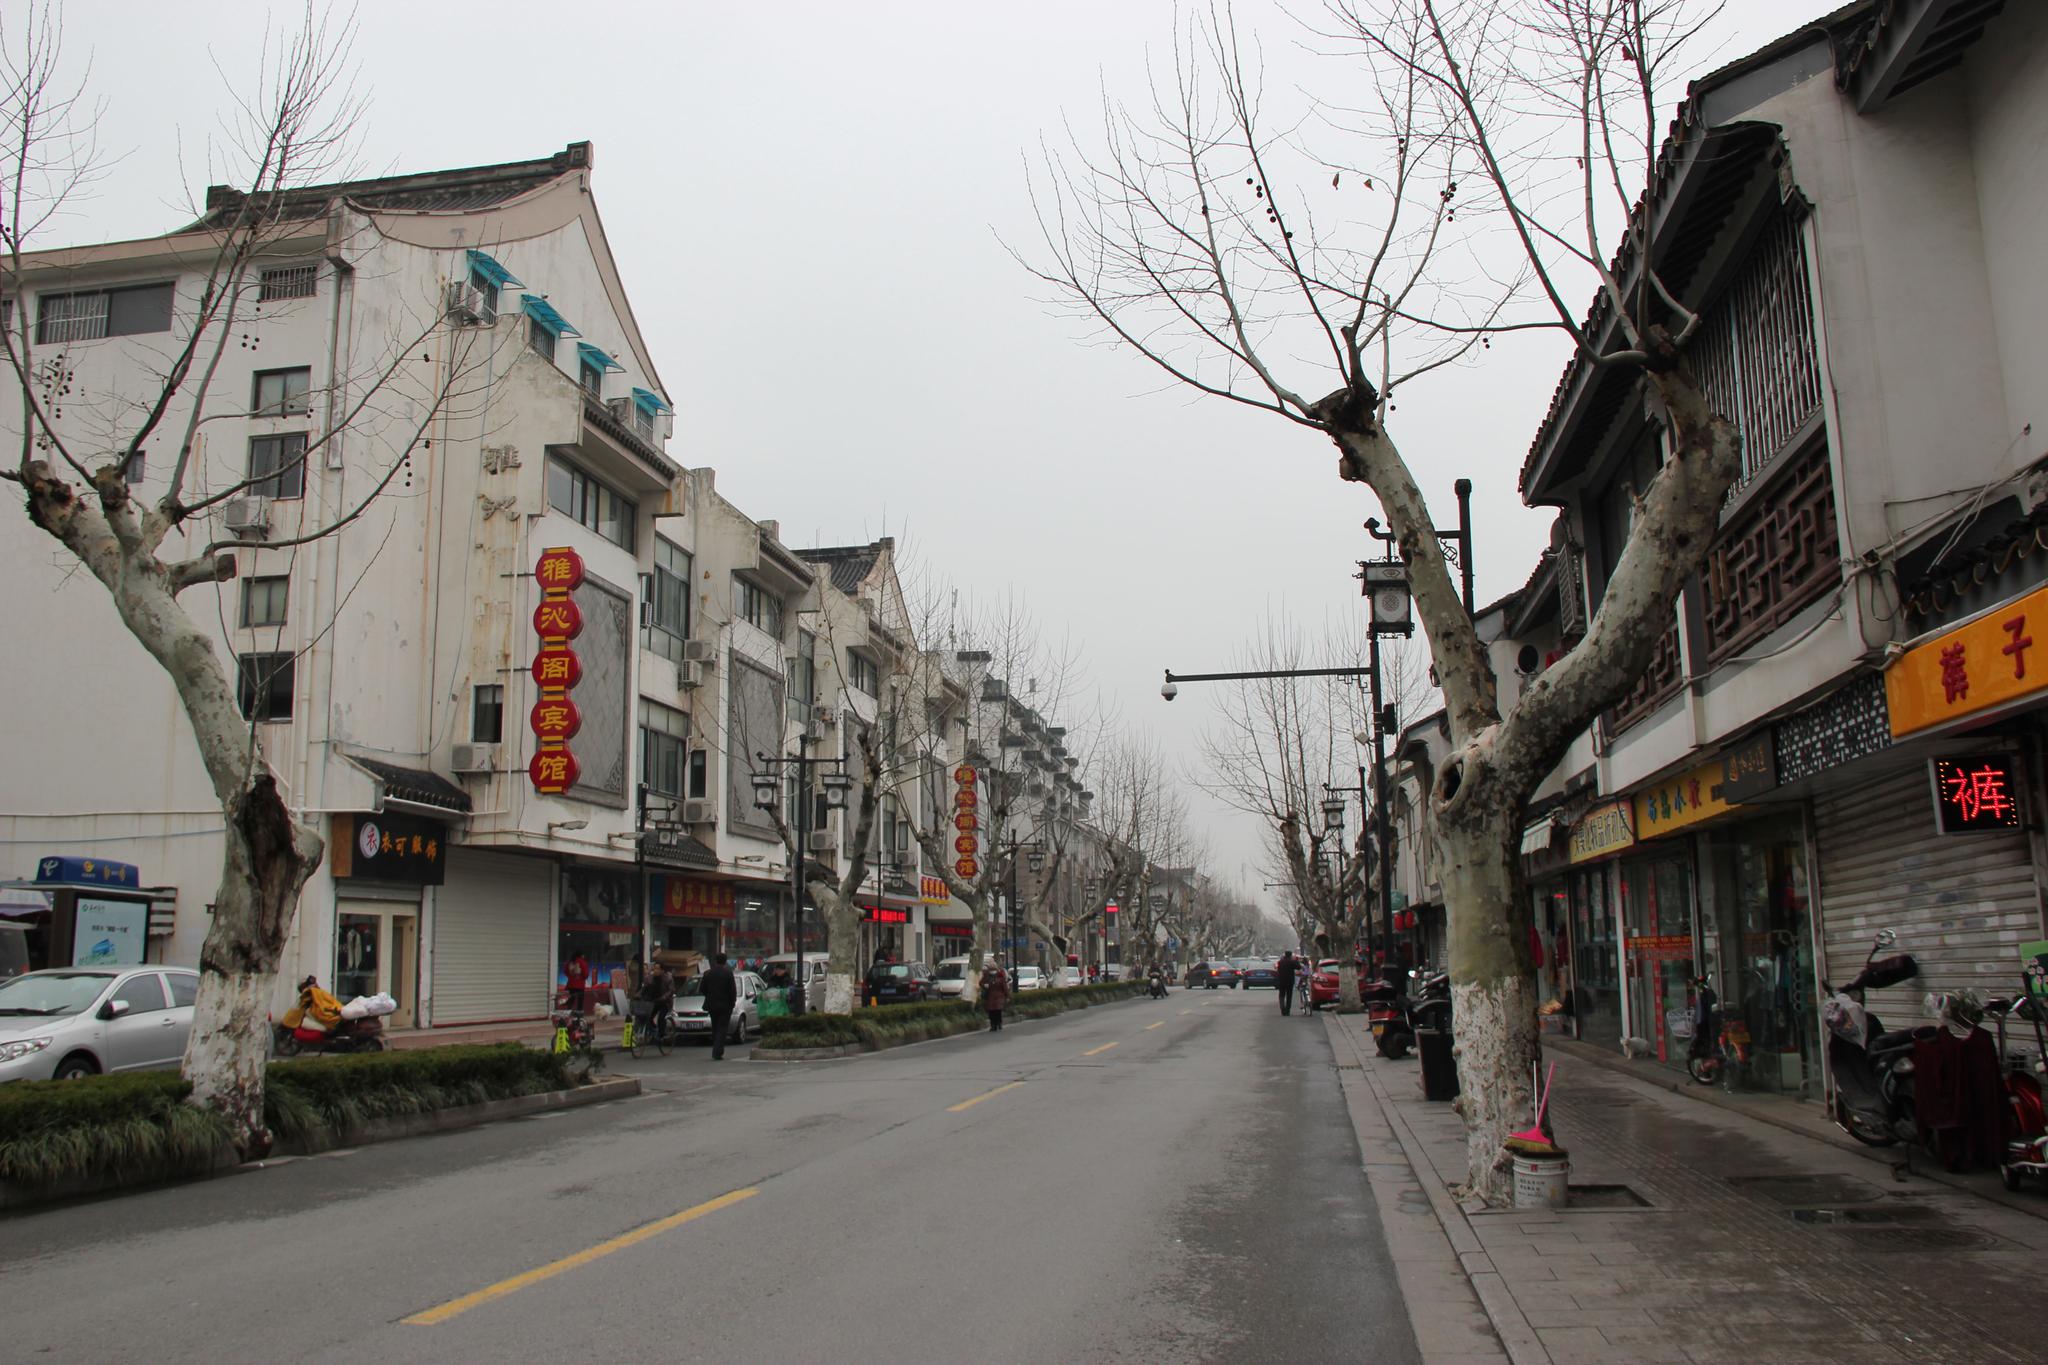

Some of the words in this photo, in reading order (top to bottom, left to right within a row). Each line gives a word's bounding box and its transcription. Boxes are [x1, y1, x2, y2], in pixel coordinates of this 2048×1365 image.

[539, 558, 572, 781] 雅沁阁宾馆
[1939, 614, 2032, 705] 裤子
[1947, 764, 2010, 821] 裤
